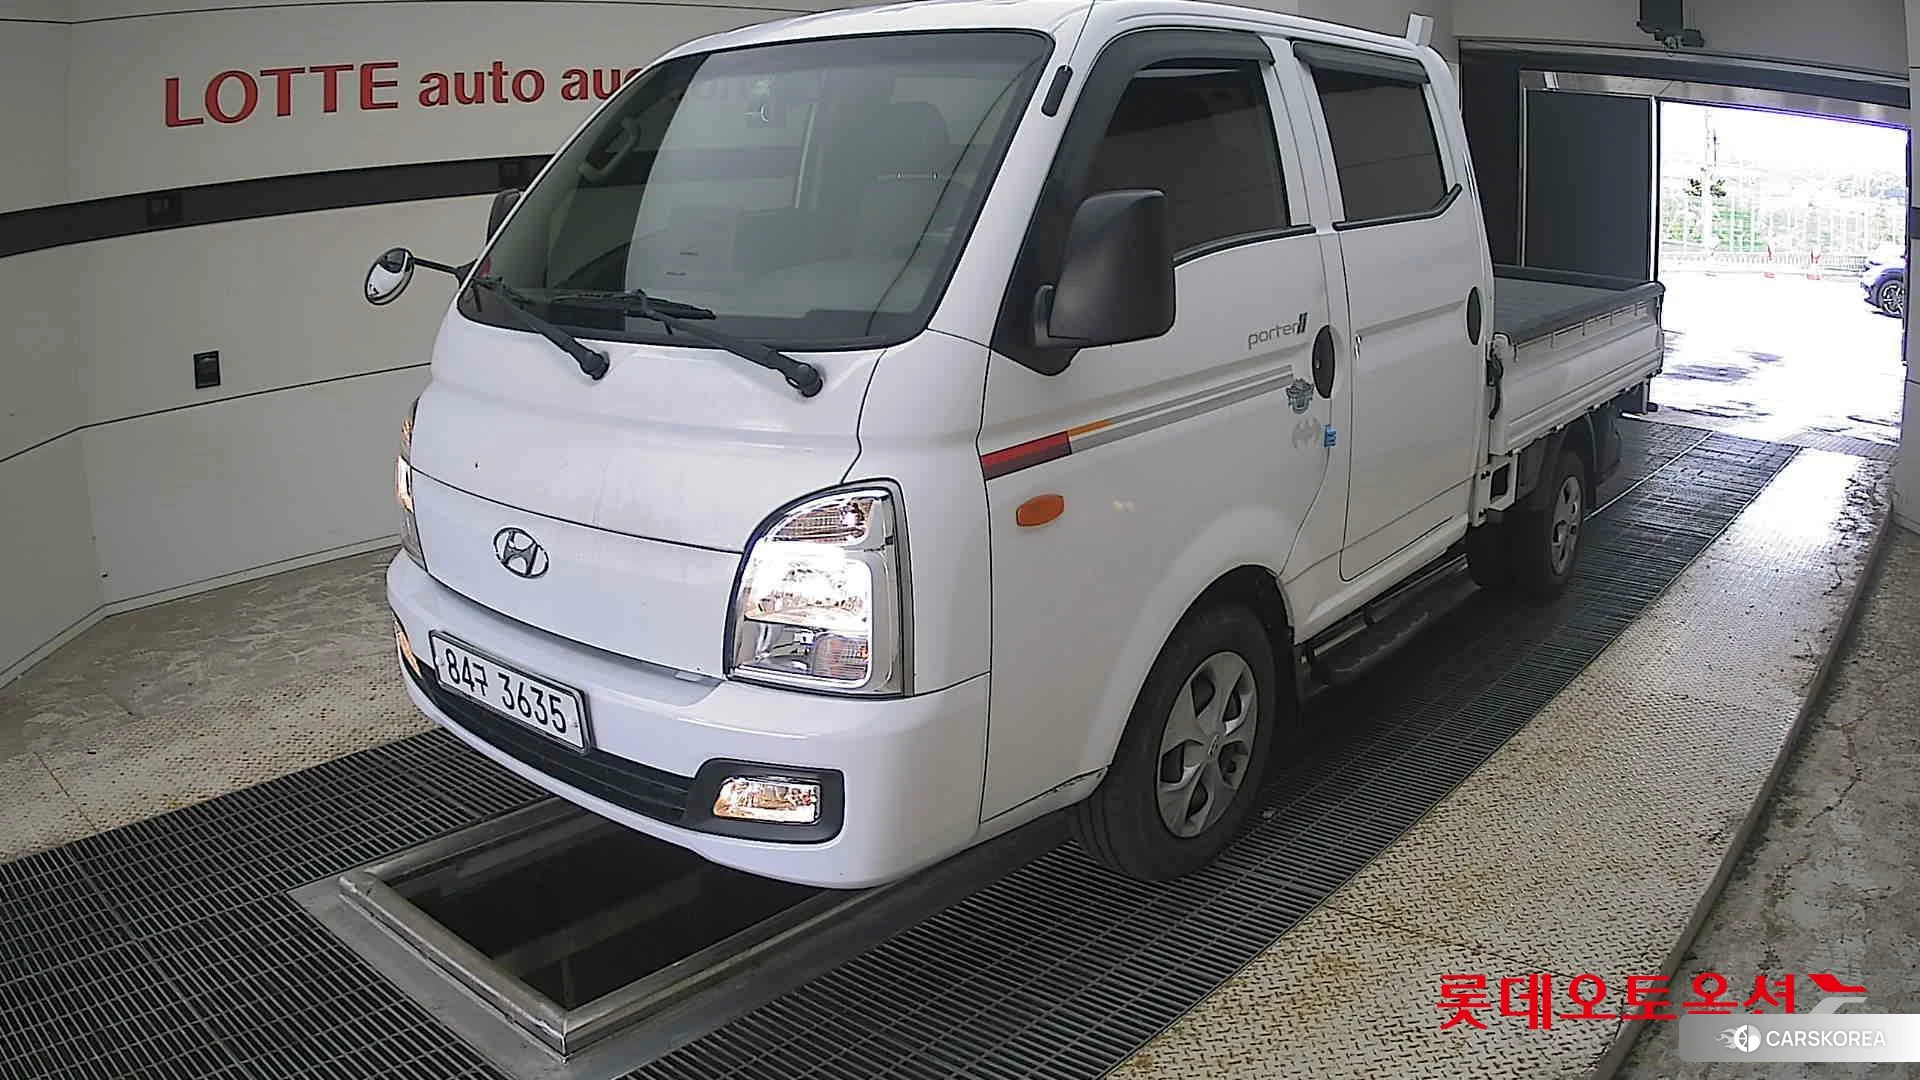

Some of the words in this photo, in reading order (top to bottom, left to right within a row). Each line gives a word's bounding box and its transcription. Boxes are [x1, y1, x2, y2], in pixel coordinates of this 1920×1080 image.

[165, 62, 399, 128] LOTTE
[418, 61, 545, 107] auto
[497, 671, 567, 734] 3635
